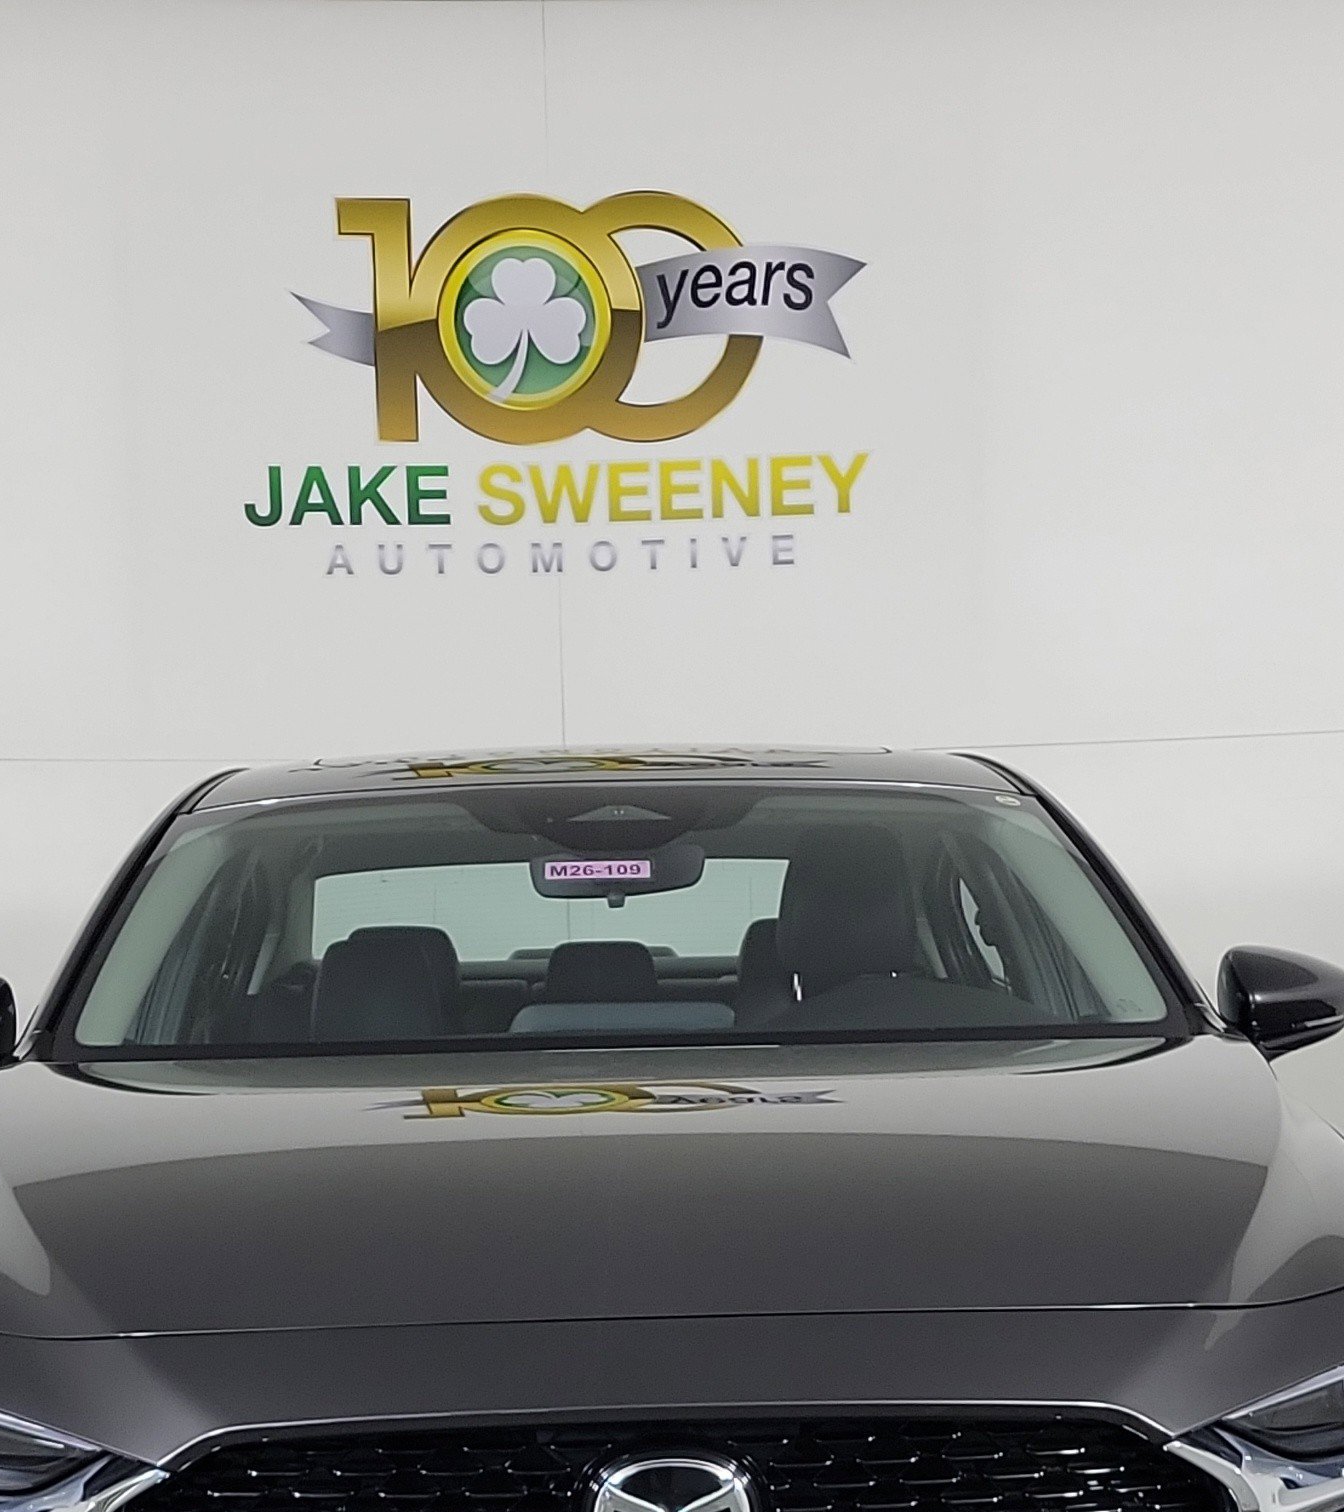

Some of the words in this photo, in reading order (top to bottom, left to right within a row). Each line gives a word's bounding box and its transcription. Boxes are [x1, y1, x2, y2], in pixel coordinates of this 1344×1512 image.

[335, 190, 763, 445] 100
[656, 261, 815, 328] years
[244, 465, 452, 527] JAKE
[477, 452, 869, 526] SWEENEY
[326, 534, 795, 576] AUTOMOTIVE
[549, 863, 642, 878] M26-109
